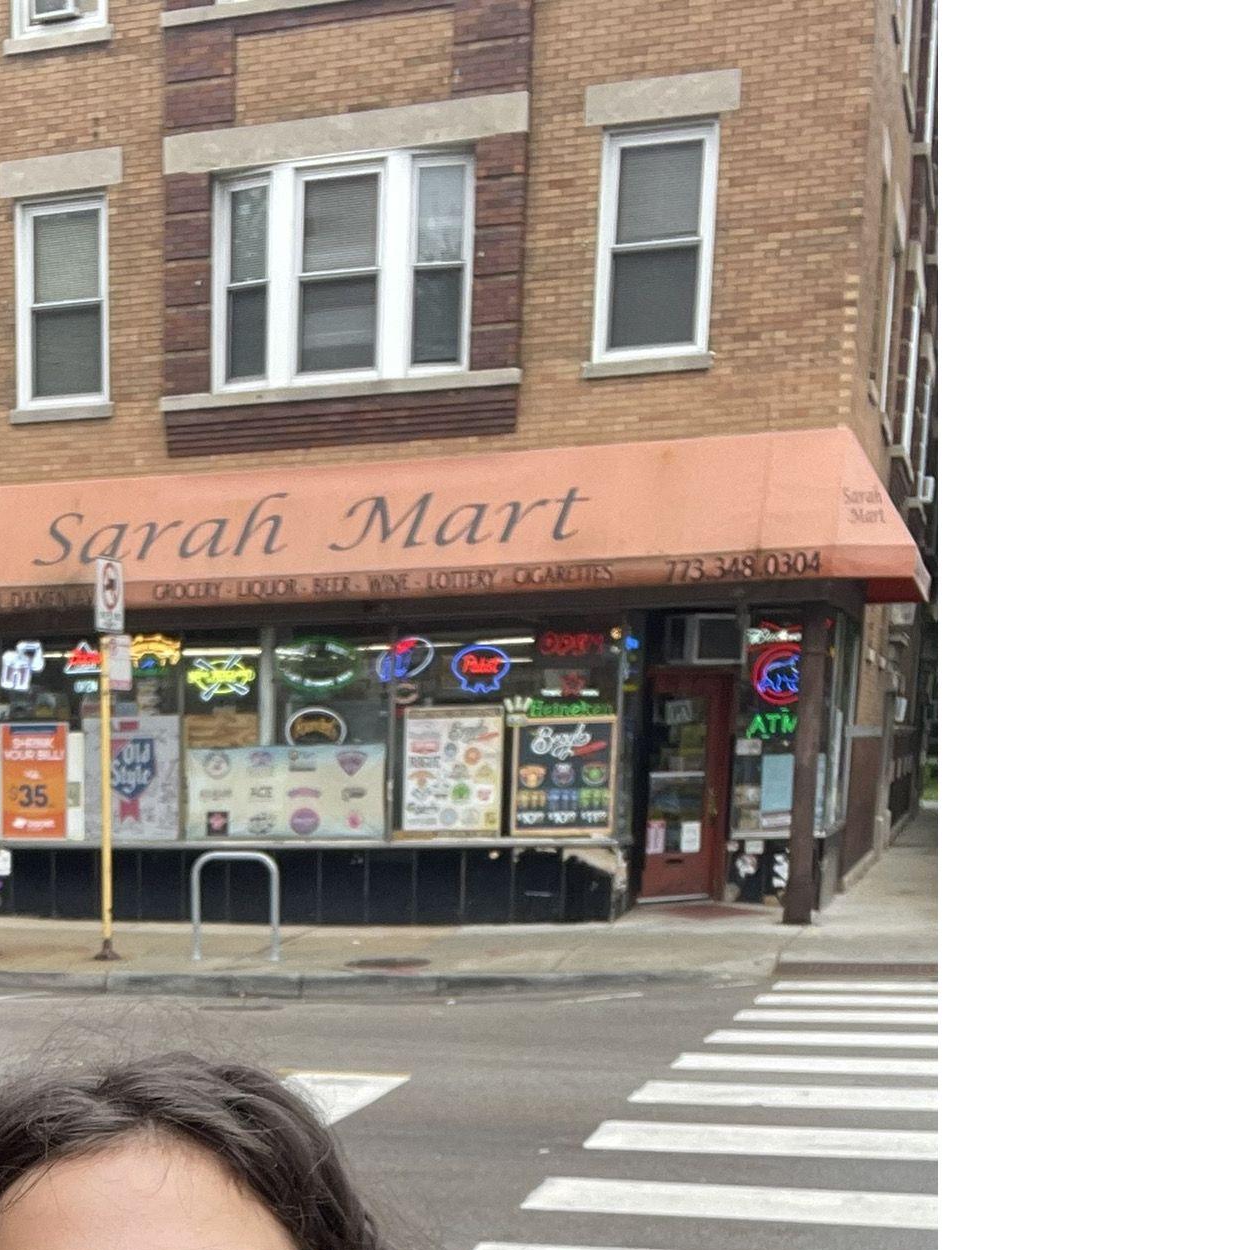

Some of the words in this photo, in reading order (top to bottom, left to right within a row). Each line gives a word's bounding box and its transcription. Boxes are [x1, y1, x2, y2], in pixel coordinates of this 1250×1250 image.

[31, 492, 289, 566] Sarah
[328, 487, 590, 551] Mart
[153, 581, 222, 600] GROCERY
[236, 578, 297, 599] LIQUOR
[313, 576, 350, 594] BEER
[367, 573, 409, 593] WINE
[427, 569, 498, 590] LOTTERY
[514, 564, 613, 584] CIGARETTES
[665, 551, 820, 583] 773.348.0304
